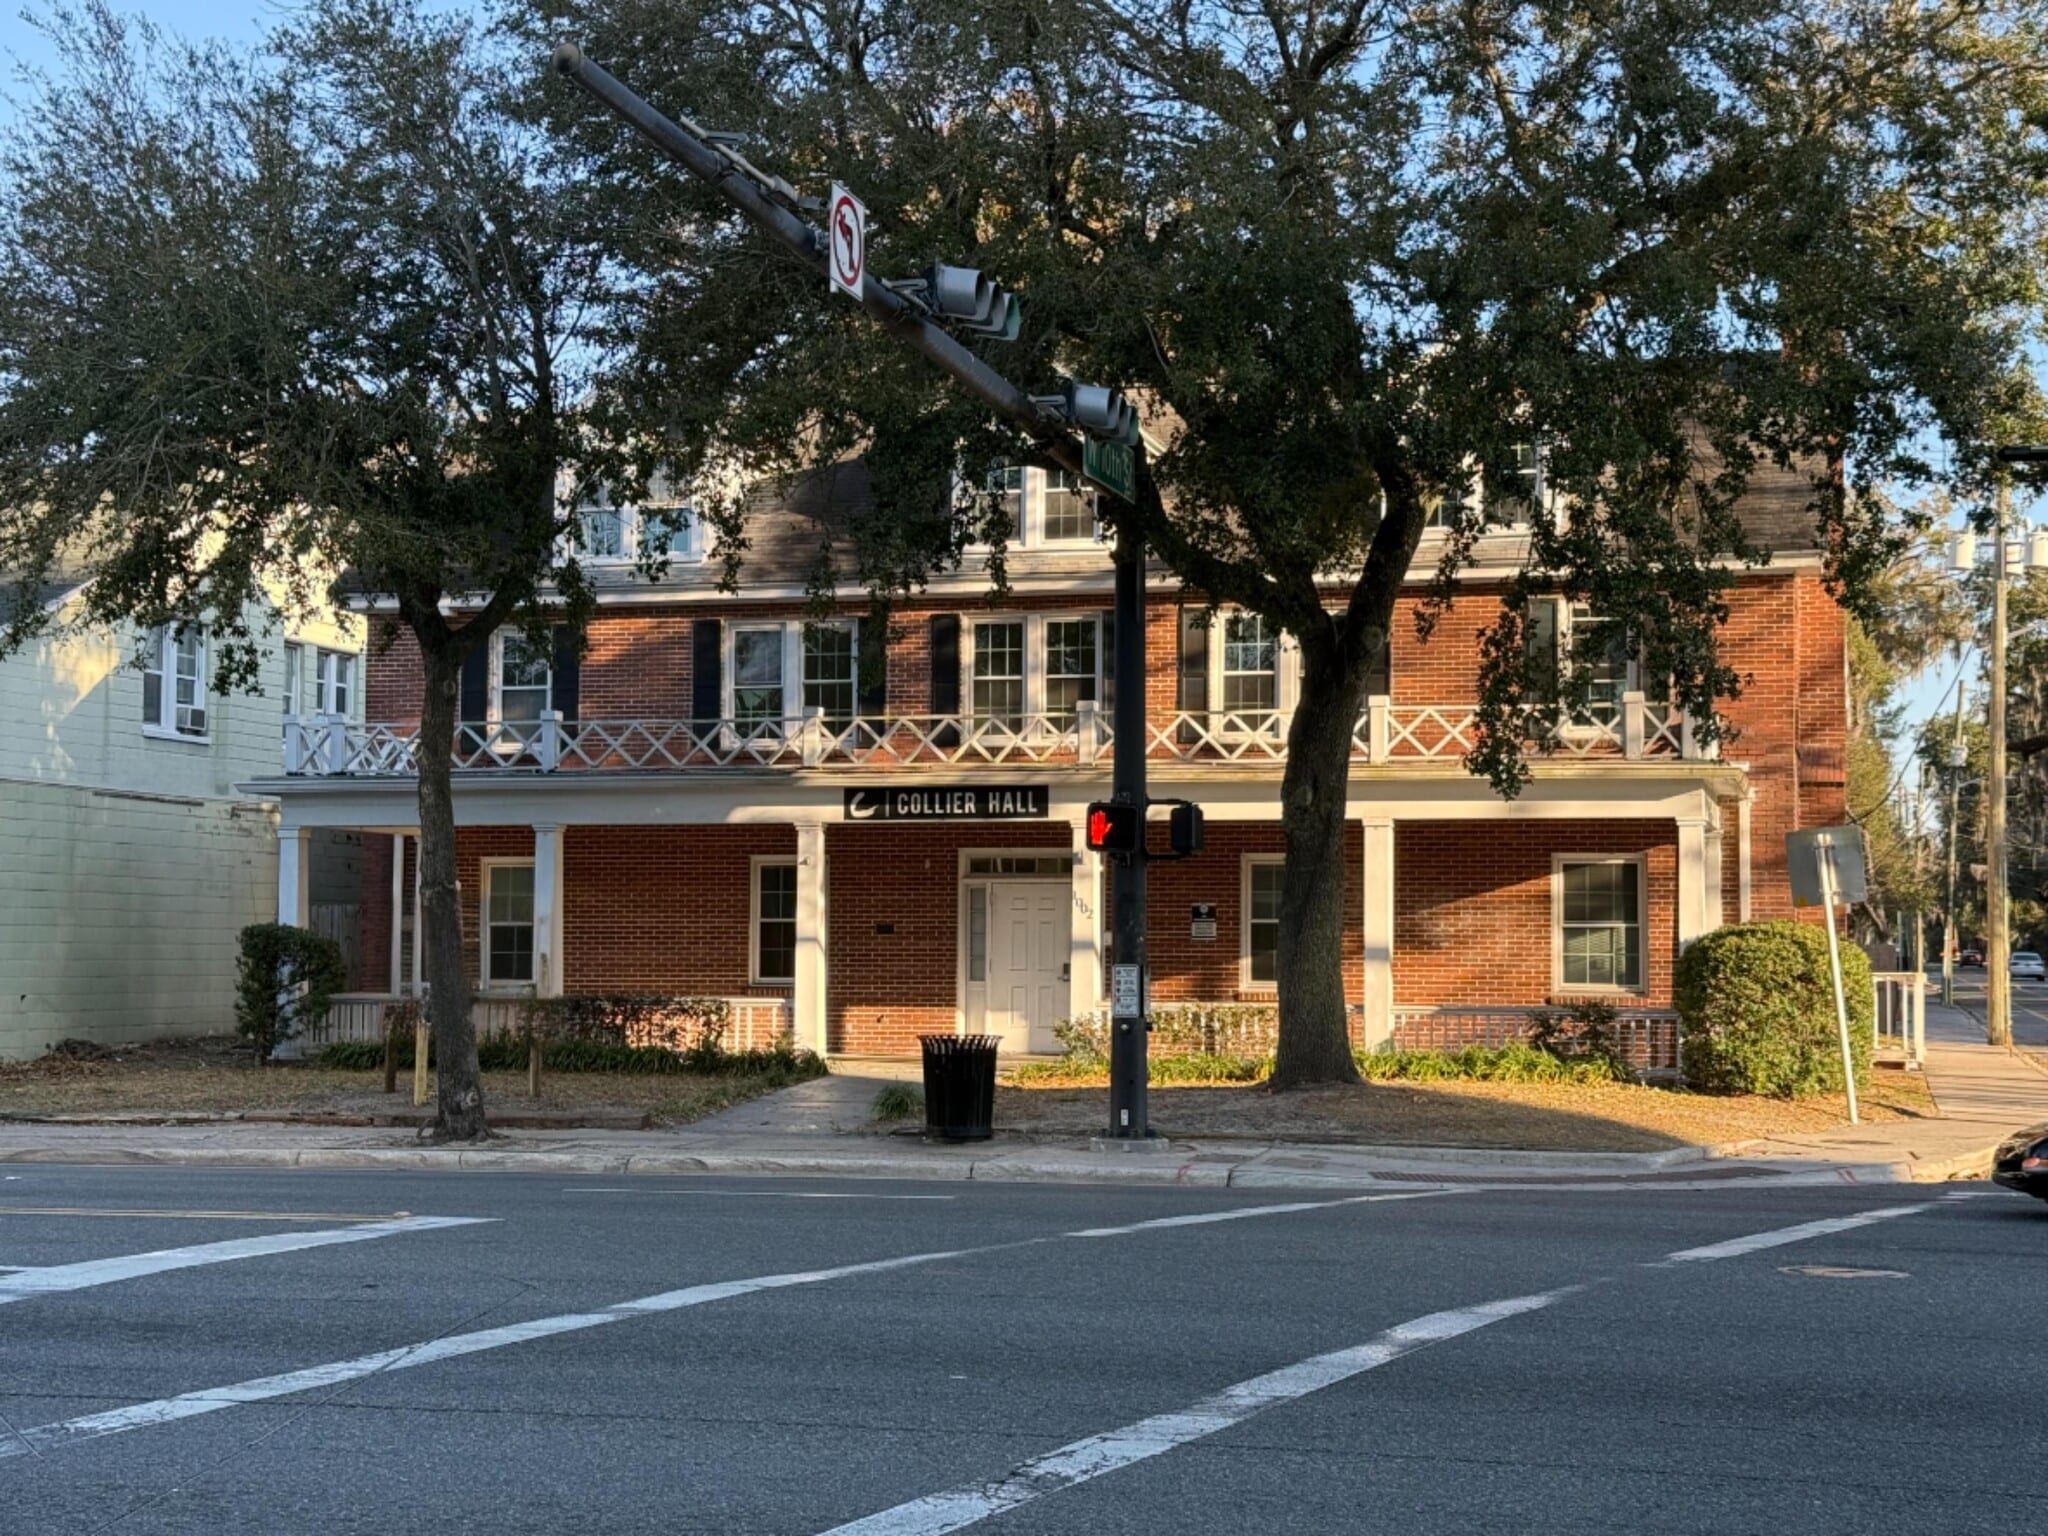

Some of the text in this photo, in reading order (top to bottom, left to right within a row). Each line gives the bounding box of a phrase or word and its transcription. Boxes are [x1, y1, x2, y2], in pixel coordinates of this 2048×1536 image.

[1101, 443, 1122, 481] 10th
[897, 791, 1038, 815] COLLIER HALL
[1073, 890, 1094, 919] 1002
